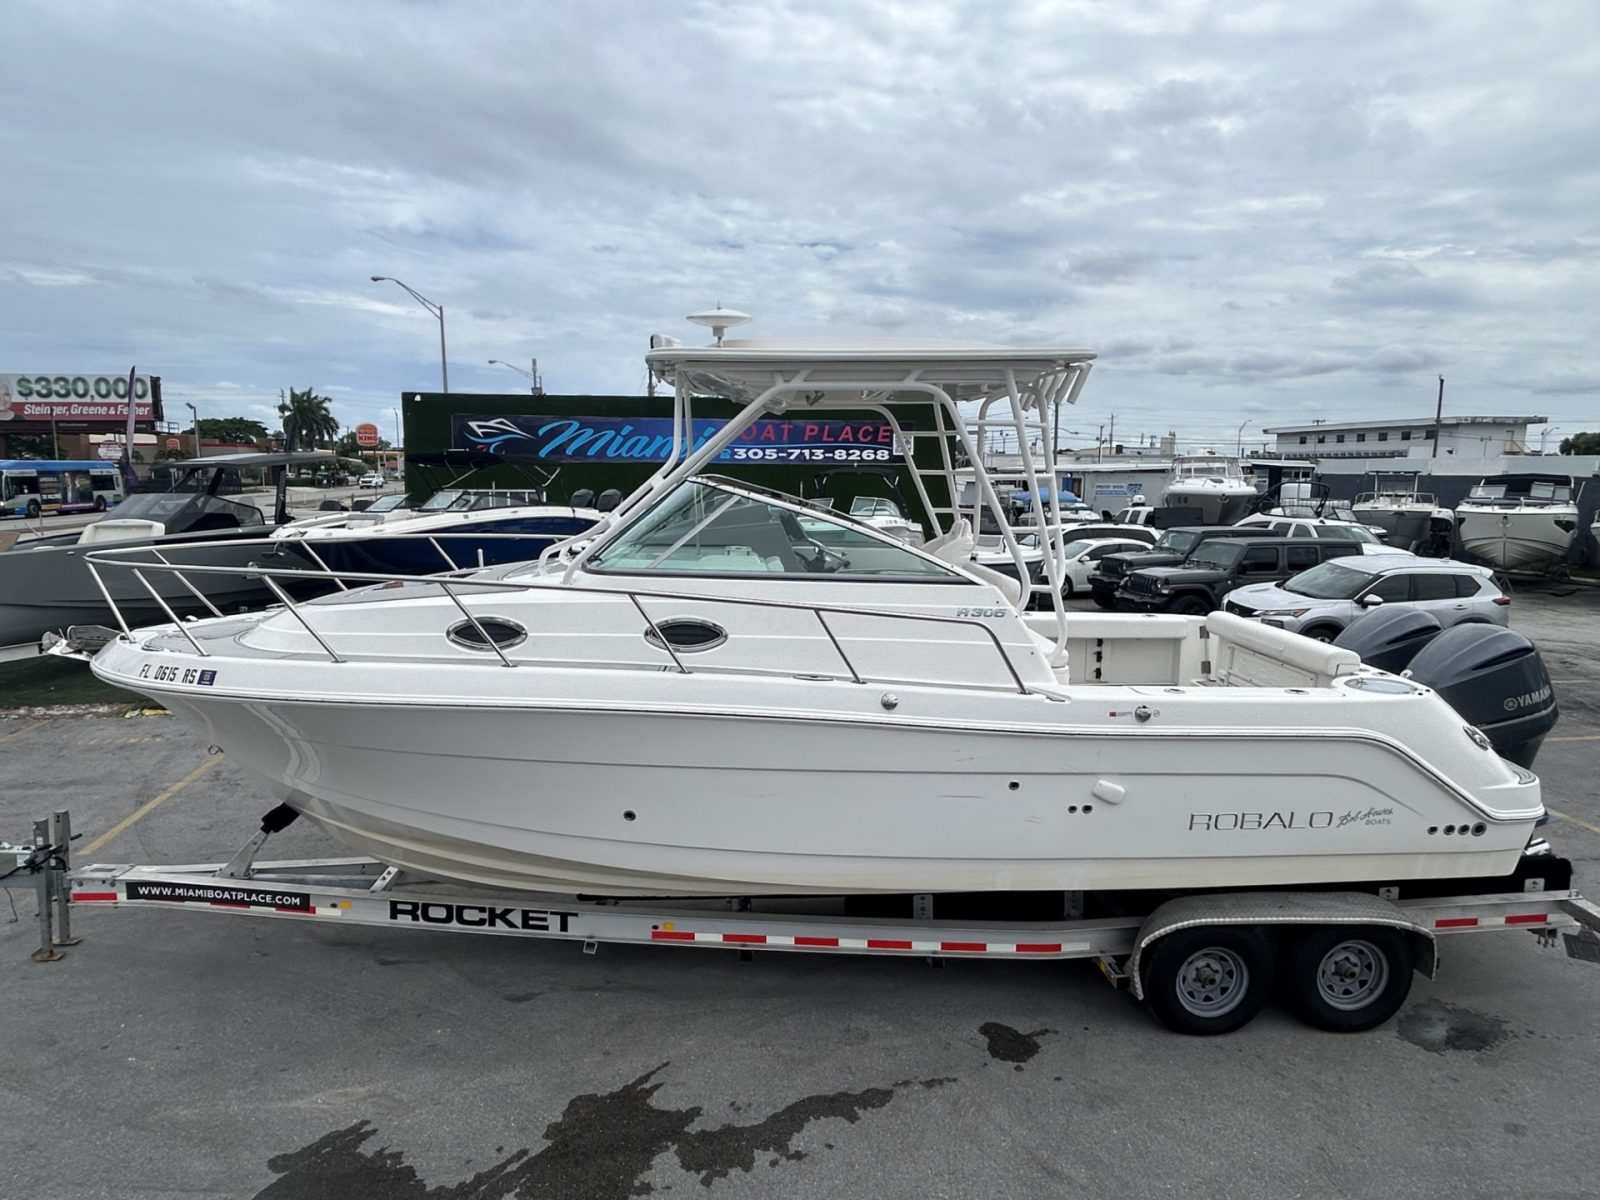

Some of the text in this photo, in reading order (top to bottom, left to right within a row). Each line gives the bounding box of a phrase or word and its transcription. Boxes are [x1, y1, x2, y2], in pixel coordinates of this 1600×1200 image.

[16, 374, 149, 401] $330,000
[70, 403, 107, 415] Greene
[117, 404, 150, 415] Fener
[537, 420, 716, 459] Miami
[739, 424, 892, 443] OAT PLACE
[734, 448, 890, 461] 305-713-8268
[139, 663, 152, 679] FL
[154, 665, 179, 682] 0615
[182, 668, 198, 684] RS
[1188, 811, 1334, 831] ROBALO
[138, 886, 301, 906] WWW.MIAMIBOATPLACE.COM
[389, 900, 579, 933] ROCKET
